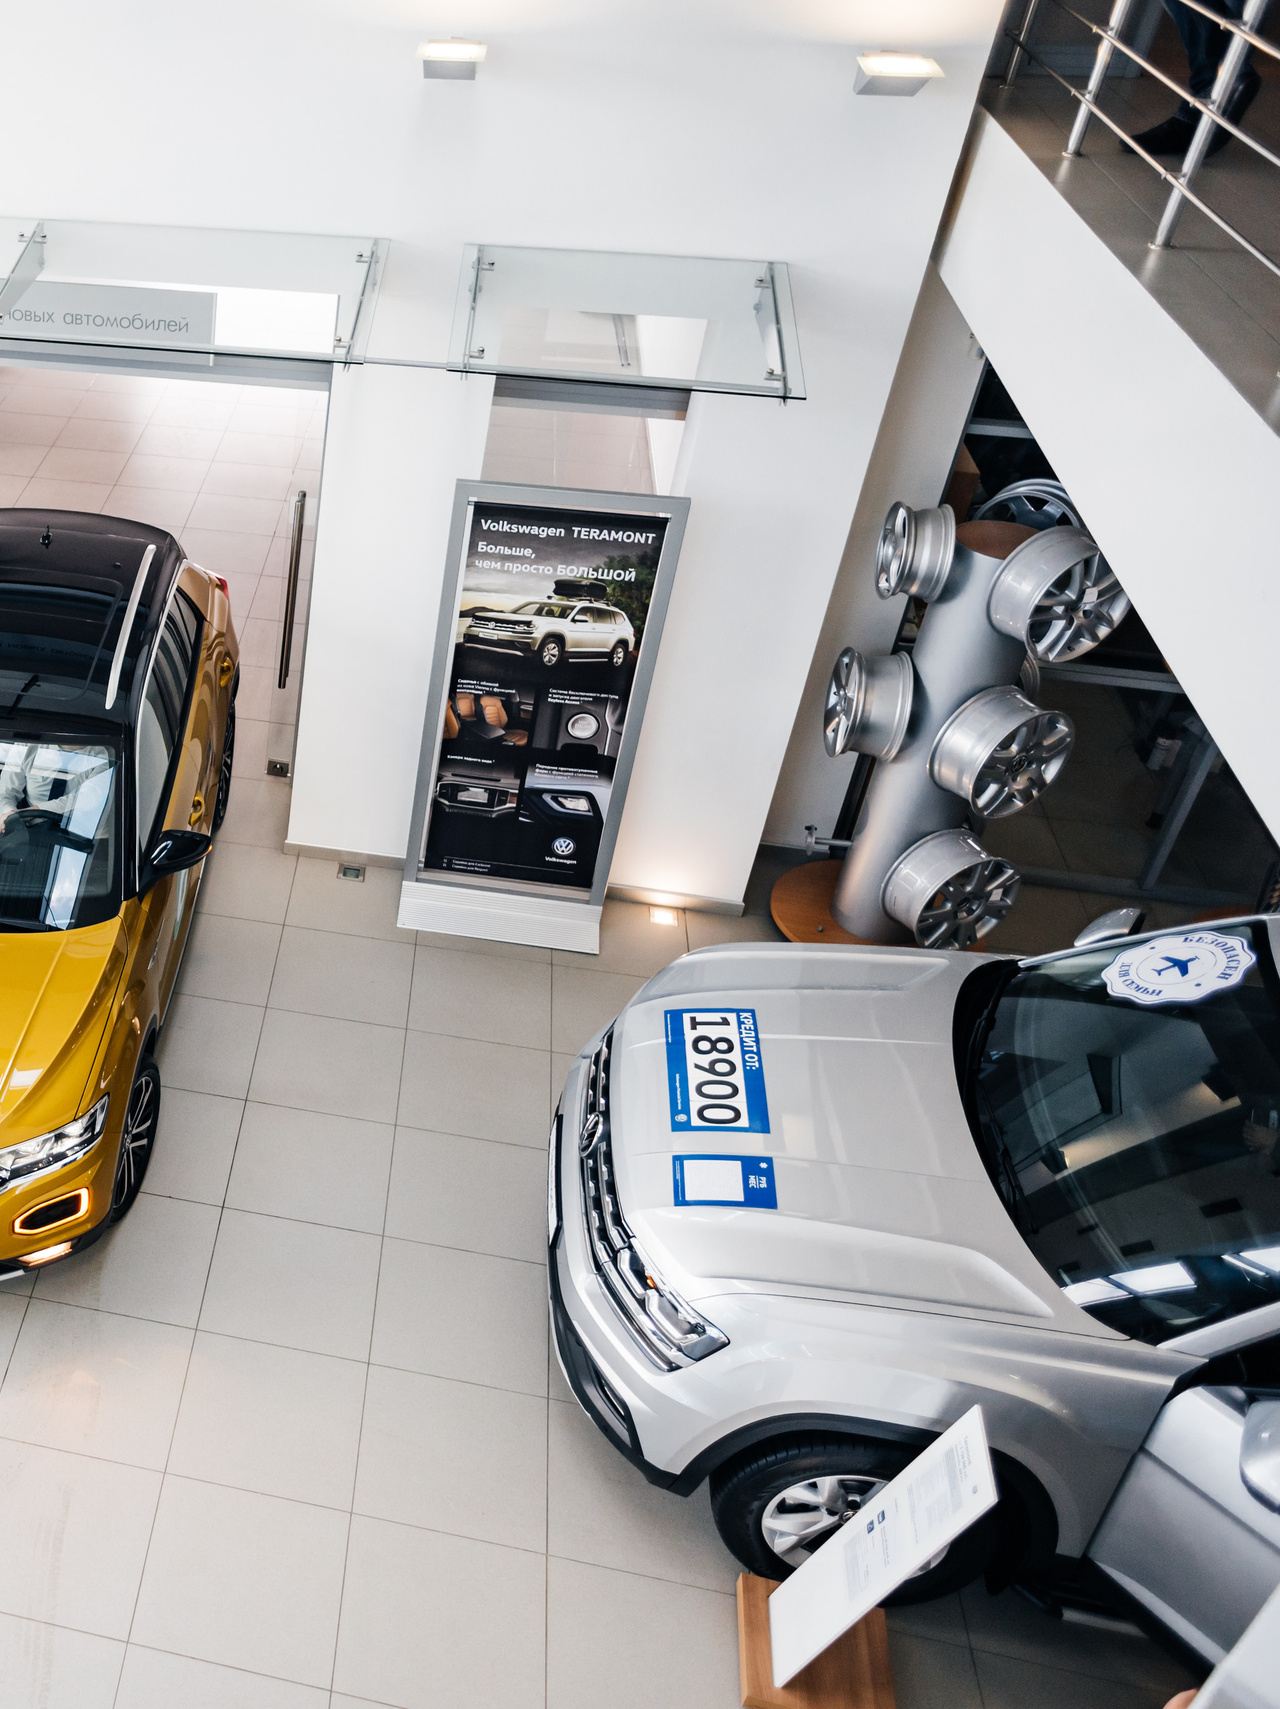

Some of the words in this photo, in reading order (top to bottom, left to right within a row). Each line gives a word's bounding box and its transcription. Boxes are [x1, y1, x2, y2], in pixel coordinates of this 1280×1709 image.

[62, 309, 190, 334] автомобилей
[480, 518, 565, 539] Volkswagen
[572, 526, 656, 545] TERAMONT
[477, 541, 536, 559] Больше,
[475, 559, 501, 570] чем
[504, 561, 554, 575] просто
[556, 564, 636, 583] БОЛЬШОЙ
[544, 855, 577, 865] Volkswagen
[1181, 936, 1241, 981] БЕЗОПАСЕН
[1118, 962, 1132, 978] ДЛЯ
[1122, 979, 1163, 997] СЕМЬИ
[739, 1012, 758, 1056] КРЕДИТ
[689, 1016, 742, 1125] 18900
[744, 1056, 759, 1070] ОТ:
[749, 1175, 757, 1188] МЕС
[759, 1176, 767, 1189] РУБ
